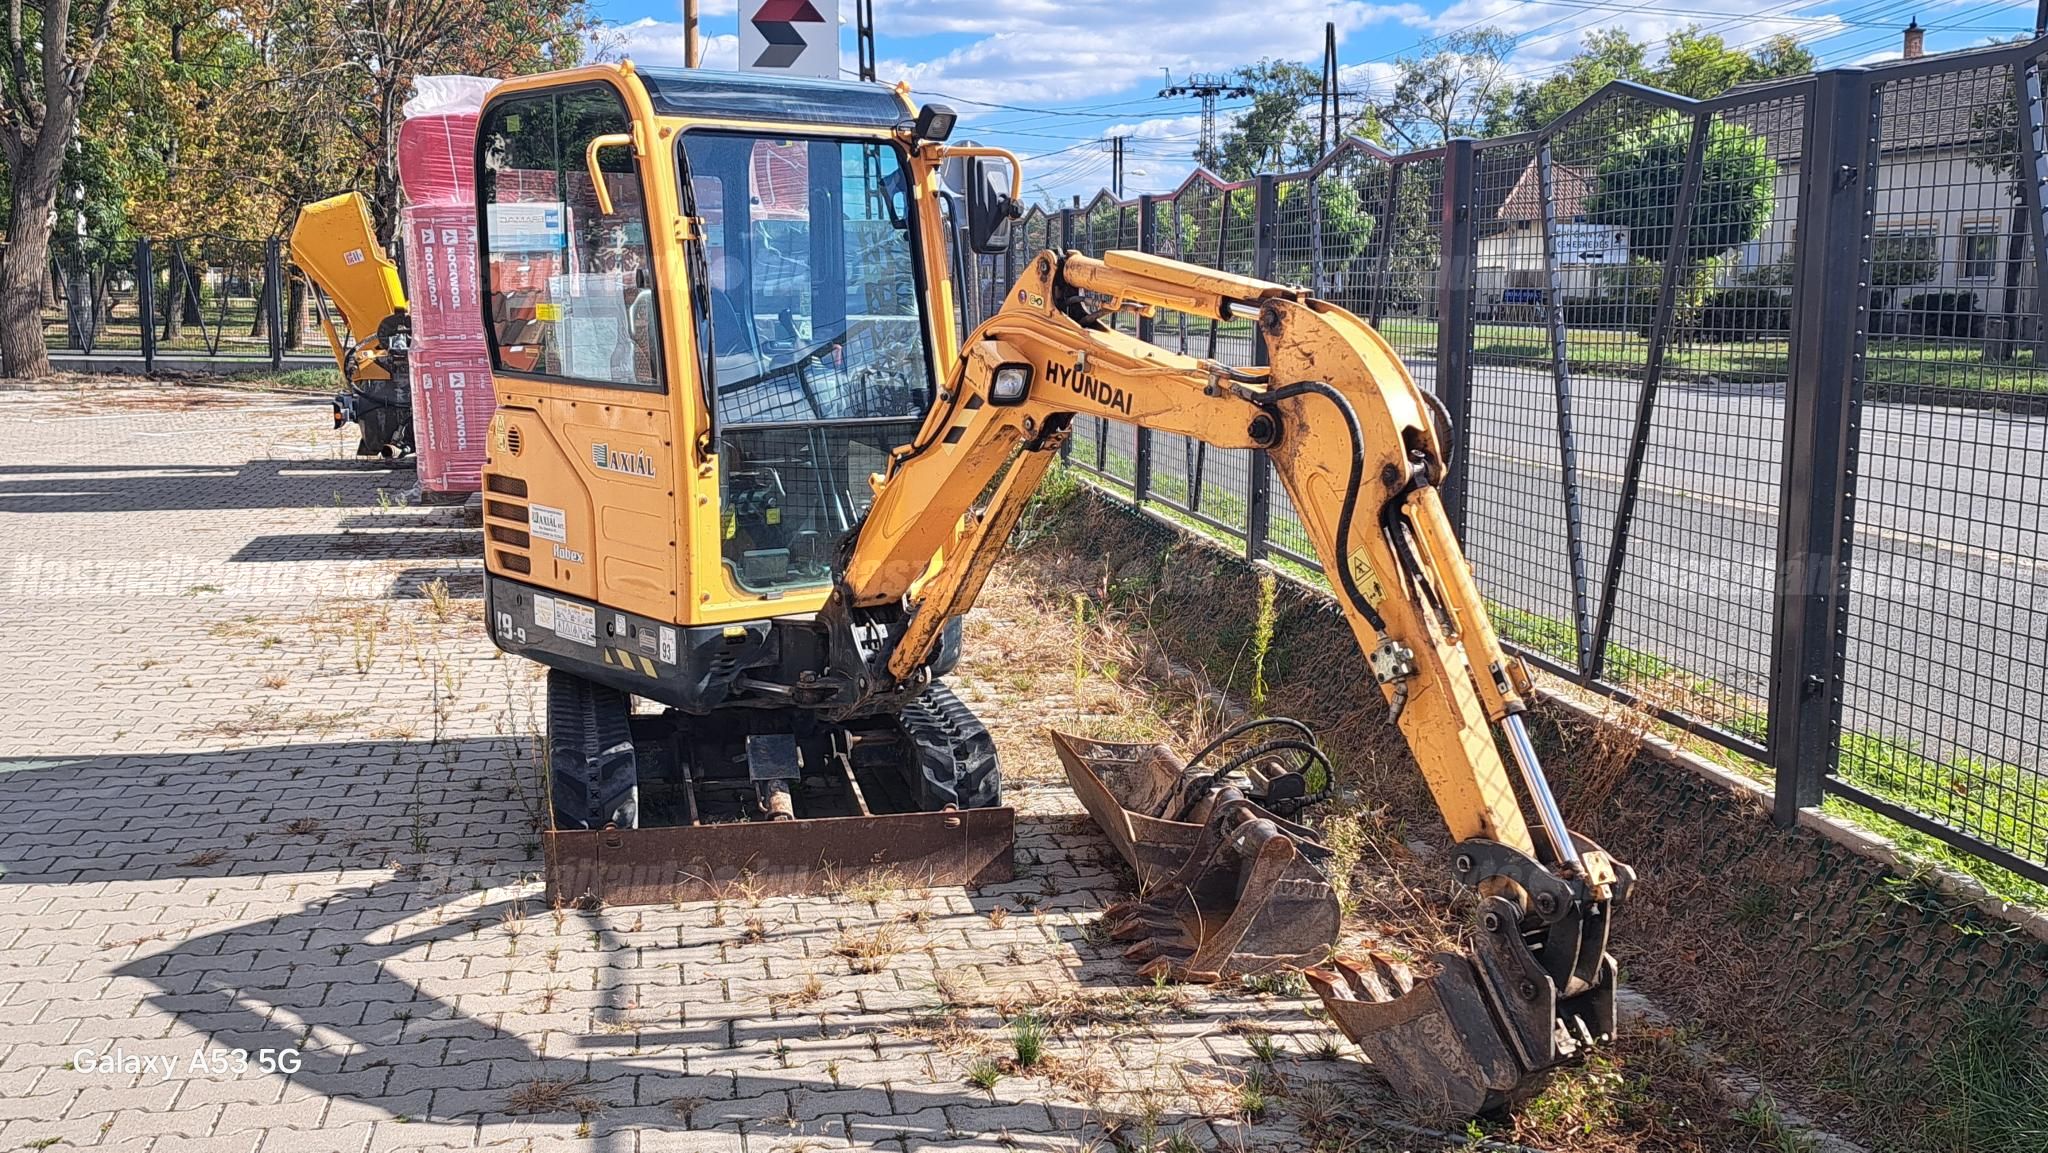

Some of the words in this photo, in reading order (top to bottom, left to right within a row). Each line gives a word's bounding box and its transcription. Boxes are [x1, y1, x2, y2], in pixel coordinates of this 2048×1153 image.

[446, 246, 461, 310] ROCKWOOL
[1045, 359, 1133, 416] HYUNDAI
[454, 389, 467, 451] ROCKWOOL
[610, 448, 655, 477] AXIÁL
[662, 642, 672, 661] 93
